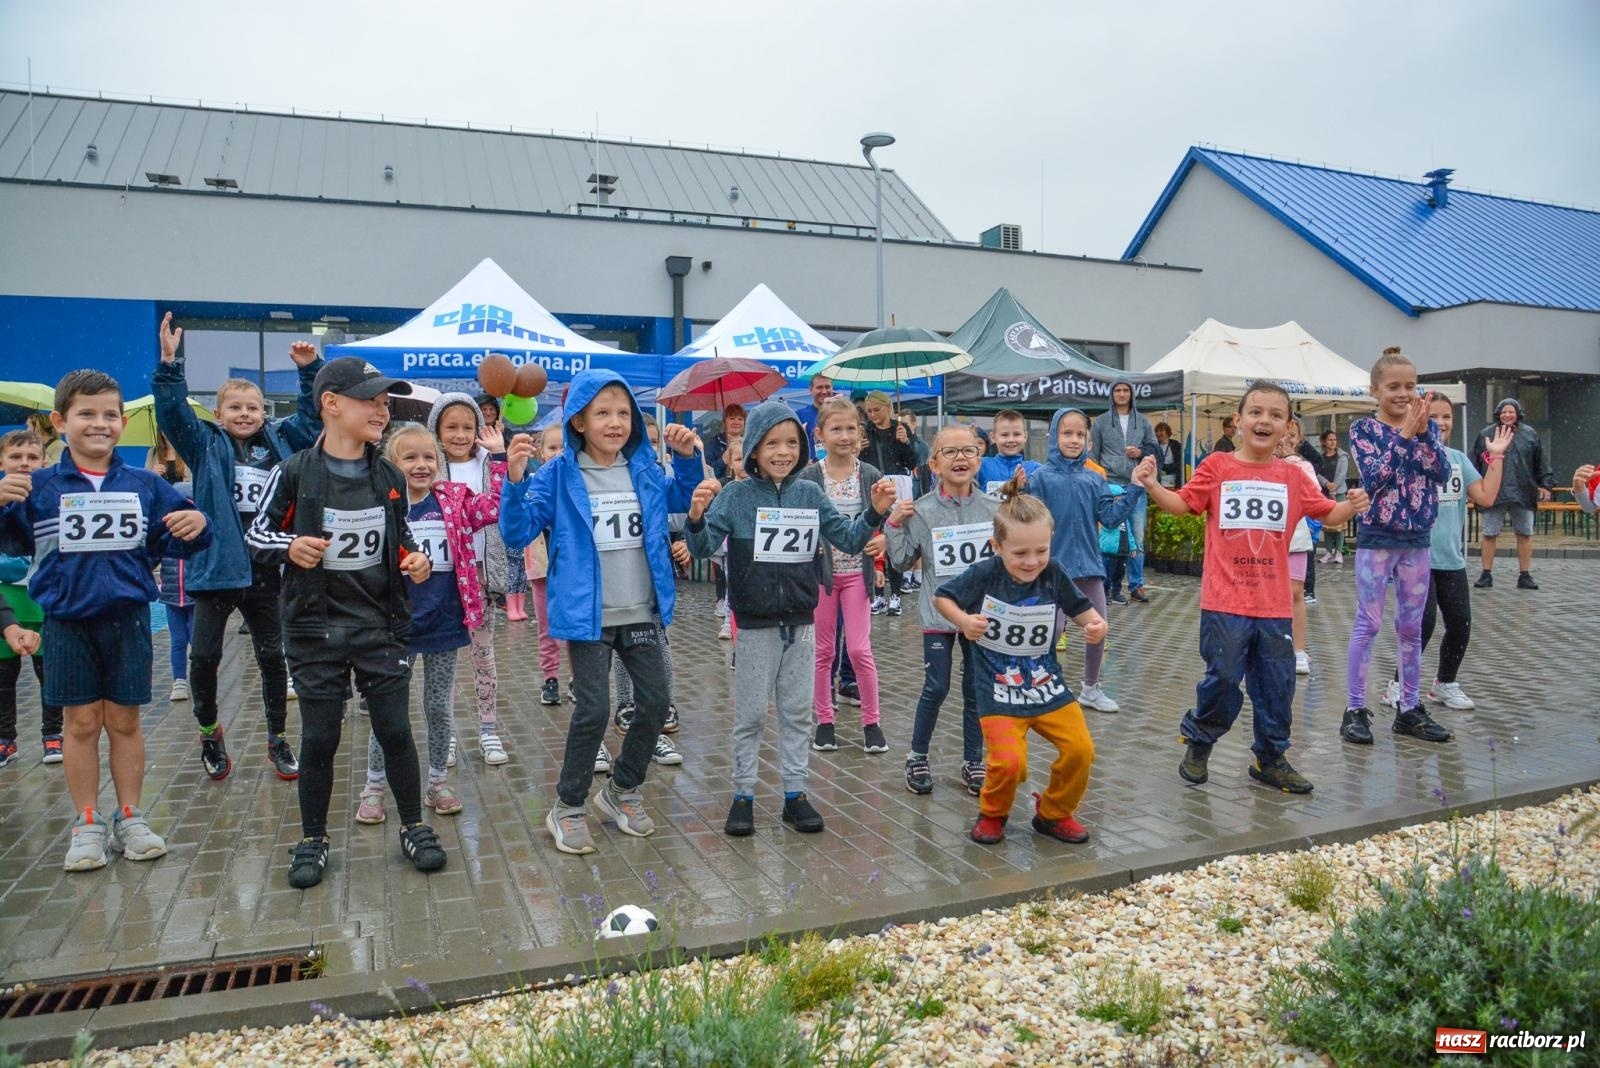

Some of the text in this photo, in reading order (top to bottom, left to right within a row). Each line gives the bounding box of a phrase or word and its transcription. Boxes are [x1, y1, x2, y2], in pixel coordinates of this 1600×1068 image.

[458, 318, 566, 347] okna
[403, 349, 591, 376] praca.eokna.pl
[983, 374, 1152, 401] Lasy Państwwe
[1224, 498, 1284, 521] 389
[64, 513, 138, 541] 325
[760, 527, 814, 552] 721
[938, 541, 995, 567] 304
[1233, 557, 1274, 566] SCIENCE
[984, 617, 1049, 647] 388
